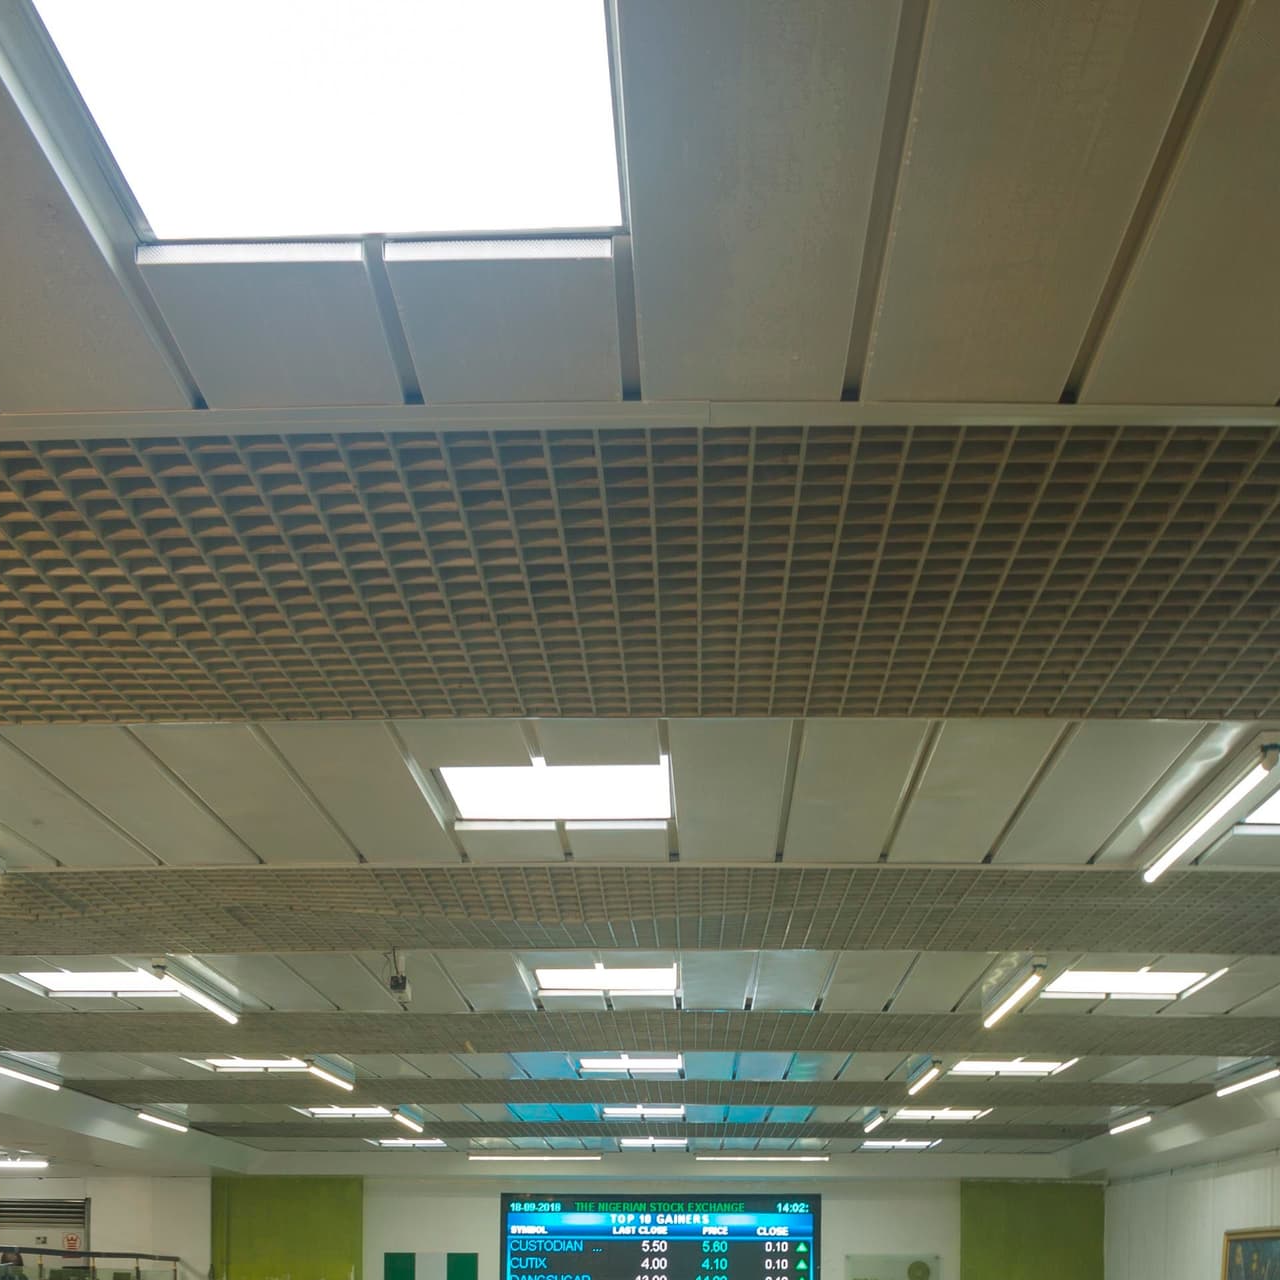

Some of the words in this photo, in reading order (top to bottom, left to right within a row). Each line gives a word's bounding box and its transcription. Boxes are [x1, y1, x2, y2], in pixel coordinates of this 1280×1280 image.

[575, 1202, 595, 1212] THE
[598, 1202, 646, 1212] NIGERIAN
[650, 1202, 686, 1212] STOCK
[688, 1203, 745, 1212] EXCHANGE
[610, 1214, 634, 1224] TOP
[656, 1214, 710, 1225] GAINERS
[612, 1226, 637, 1235] LAST
[638, 1226, 668, 1235] CLOSE
[702, 1227, 729, 1236] PRICE
[756, 1227, 789, 1236] CLOSE
[510, 1239, 584, 1252] CUSTODIAN
[642, 1240, 668, 1252] 5.50
[702, 1240, 729, 1253] 5.60
[765, 1241, 789, 1252] 0.10
[510, 1257, 547, 1269] CUTIX
[641, 1257, 668, 1270] 4.00
[701, 1258, 729, 1270] 4.10
[765, 1259, 789, 1270] 0.10
